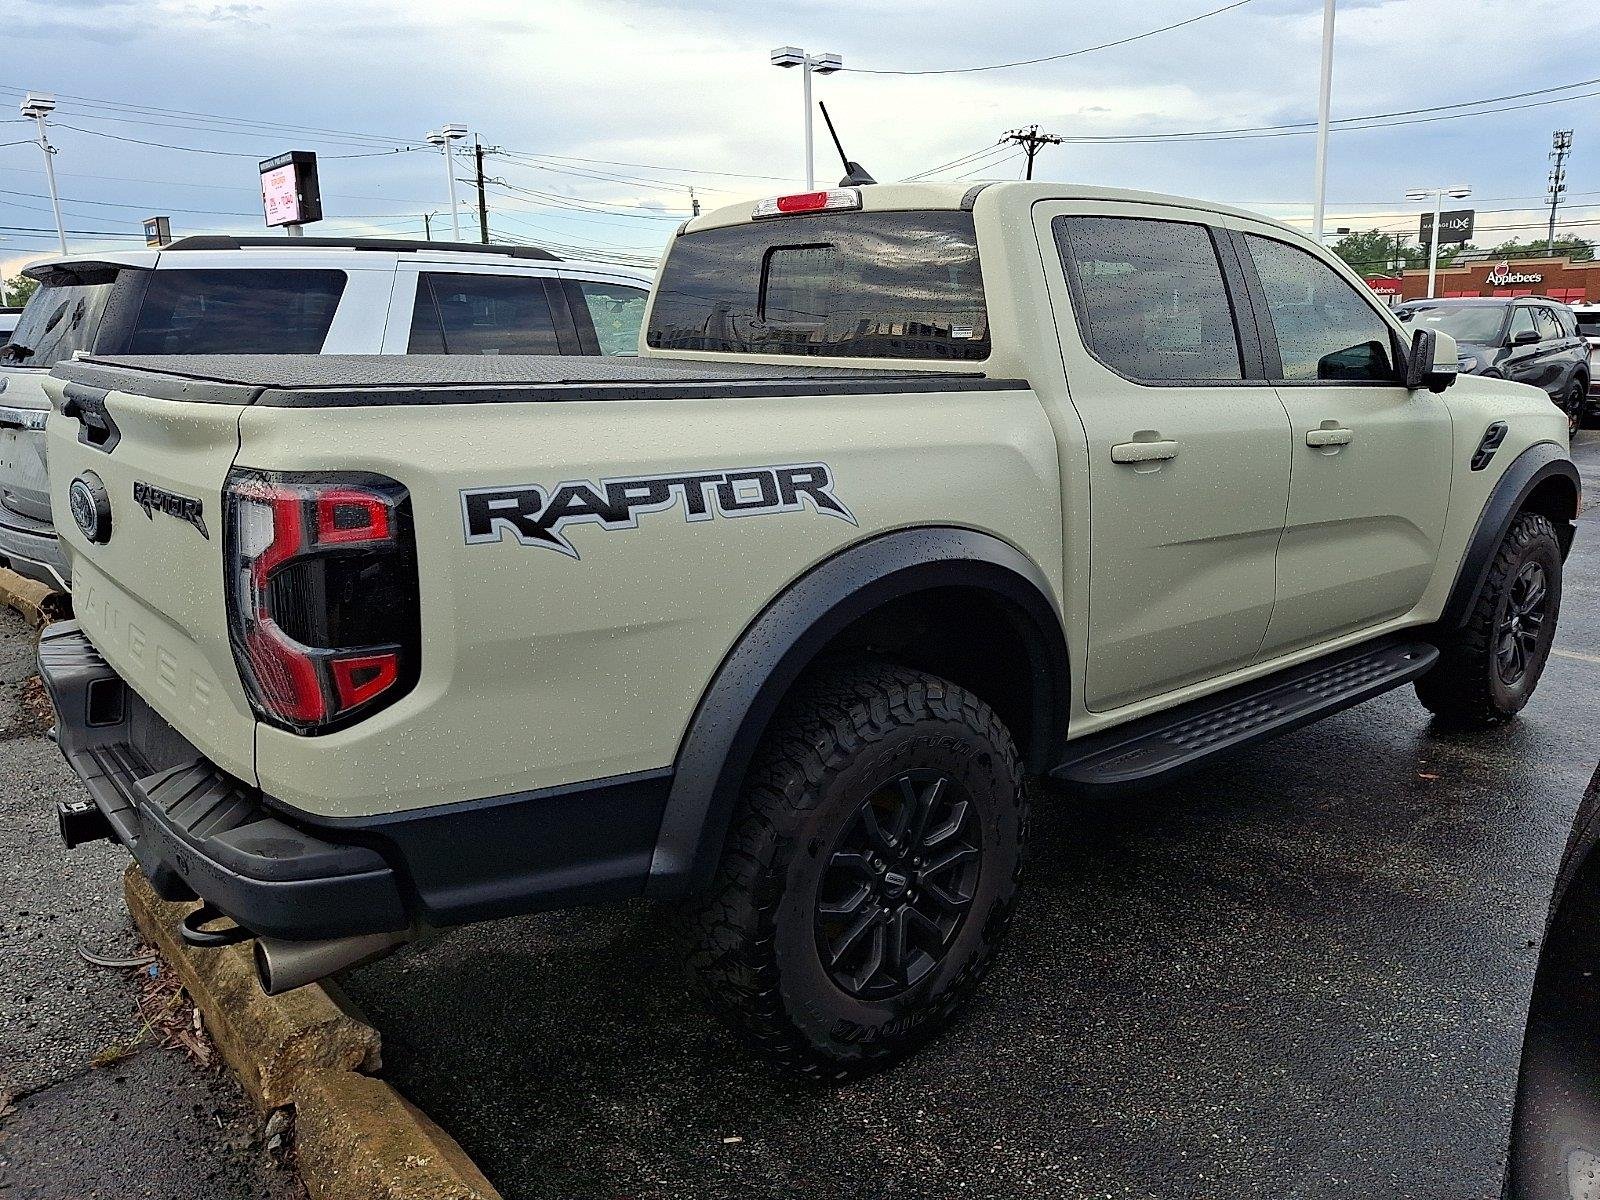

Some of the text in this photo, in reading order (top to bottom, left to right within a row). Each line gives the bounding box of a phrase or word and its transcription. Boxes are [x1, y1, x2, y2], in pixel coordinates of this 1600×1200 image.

[1449, 217, 1469, 229] LUXE
[1485, 271, 1542, 285] Applebee's
[133, 480, 209, 540] RAPTOR
[460, 462, 858, 558] RAPTOR
